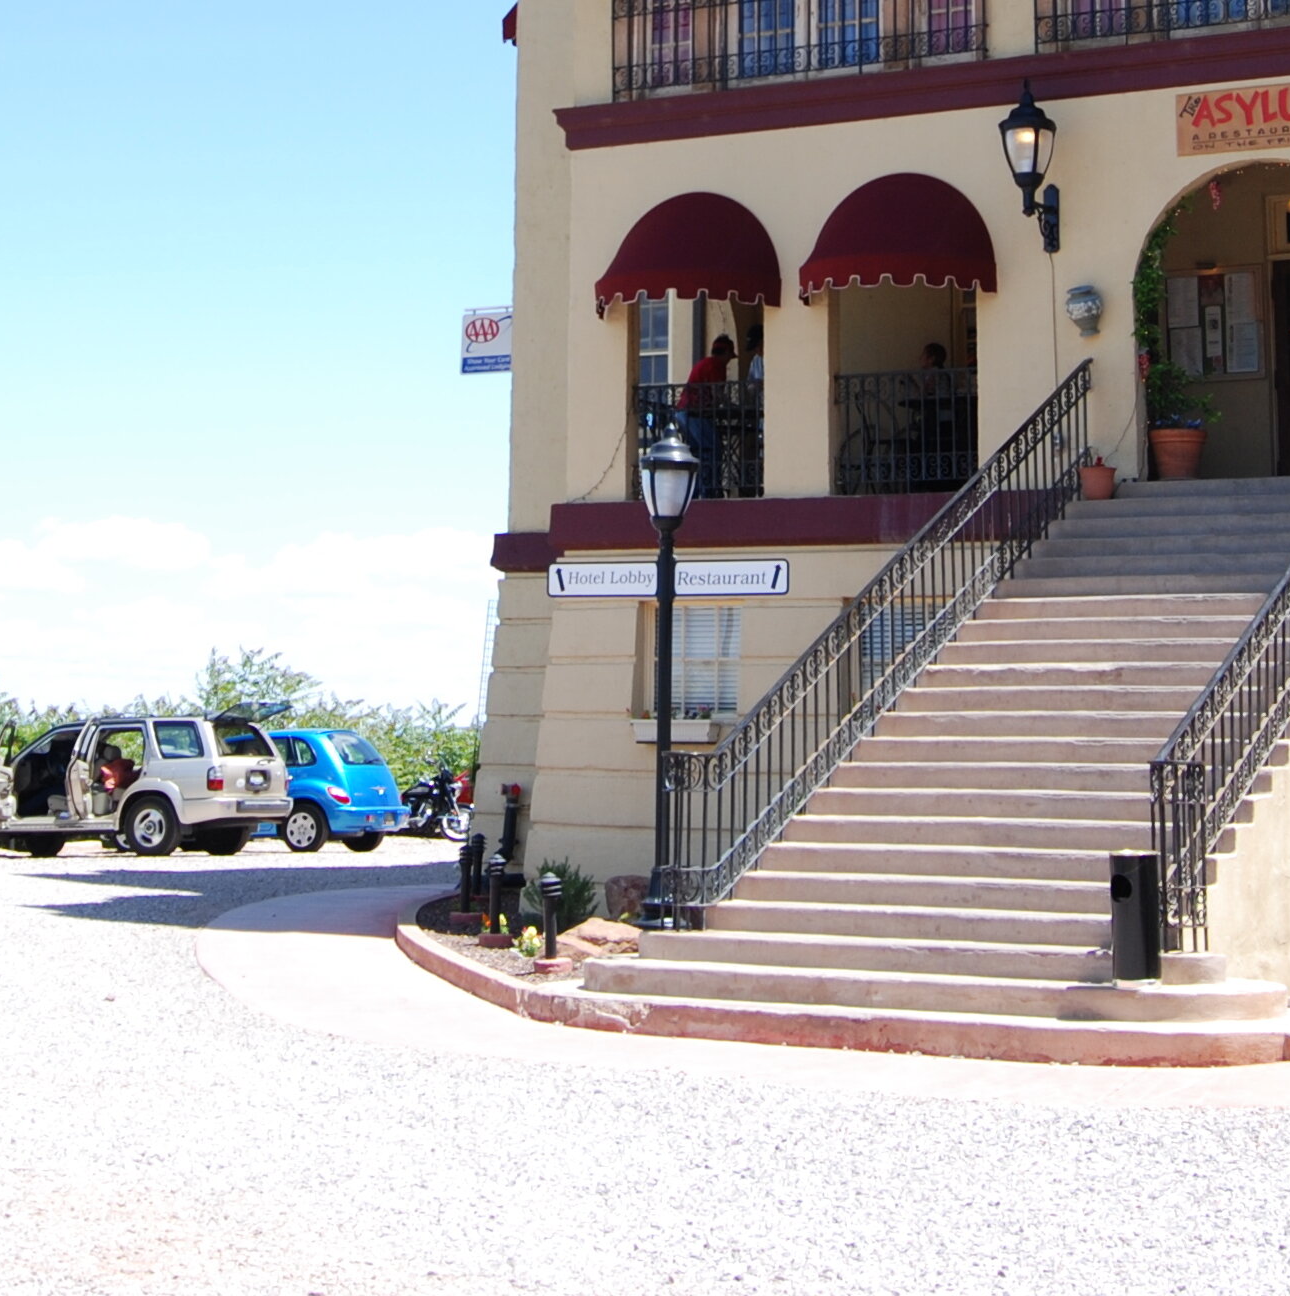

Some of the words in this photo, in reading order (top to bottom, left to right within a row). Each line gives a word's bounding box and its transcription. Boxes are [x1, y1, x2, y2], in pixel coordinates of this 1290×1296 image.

[1192, 133, 1200, 141] A
[1226, 139, 1258, 147] THE
[467, 318, 499, 342] AAA
[568, 571, 606, 585] Hotel
[610, 570, 655, 587] Lobby
[677, 570, 767, 586] Restaurant
